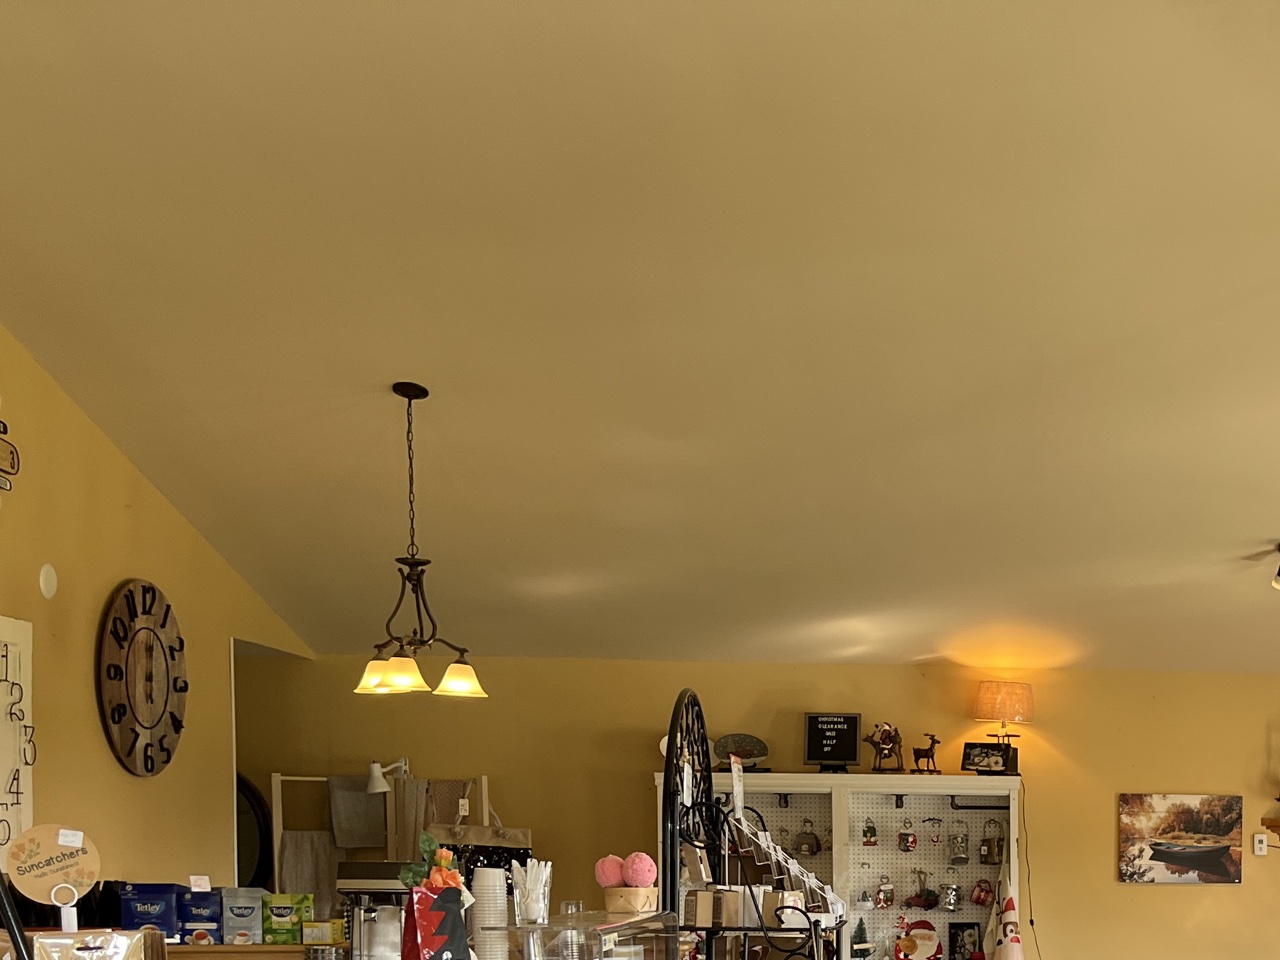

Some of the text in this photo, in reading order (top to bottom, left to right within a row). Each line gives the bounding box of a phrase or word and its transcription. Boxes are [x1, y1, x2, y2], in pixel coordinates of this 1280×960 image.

[124, 589, 139, 622] 11
[141, 585, 157, 615] 12
[160, 604, 171, 629] 1
[110, 616, 129, 650] 10
[169, 636, 184, 661] 2
[106, 664, 124, 681] 9
[173, 677, 188, 693] 3
[9, 682, 25, 722] 2
[111, 703, 127, 724] 8
[168, 711, 184, 734] 4
[23, 725, 37, 766] 3
[127, 727, 140, 758] 7
[158, 735, 171, 764] 5
[143, 743, 155, 773] 6
[9, 768, 24, 806] 4
[16, 847, 88, 876] Suncatchers
[135, 903, 160, 914] Tetley
[191, 907, 210, 916] Tetley
[233, 907, 253, 916] Tetley
[272, 907, 292, 916] Tetley
